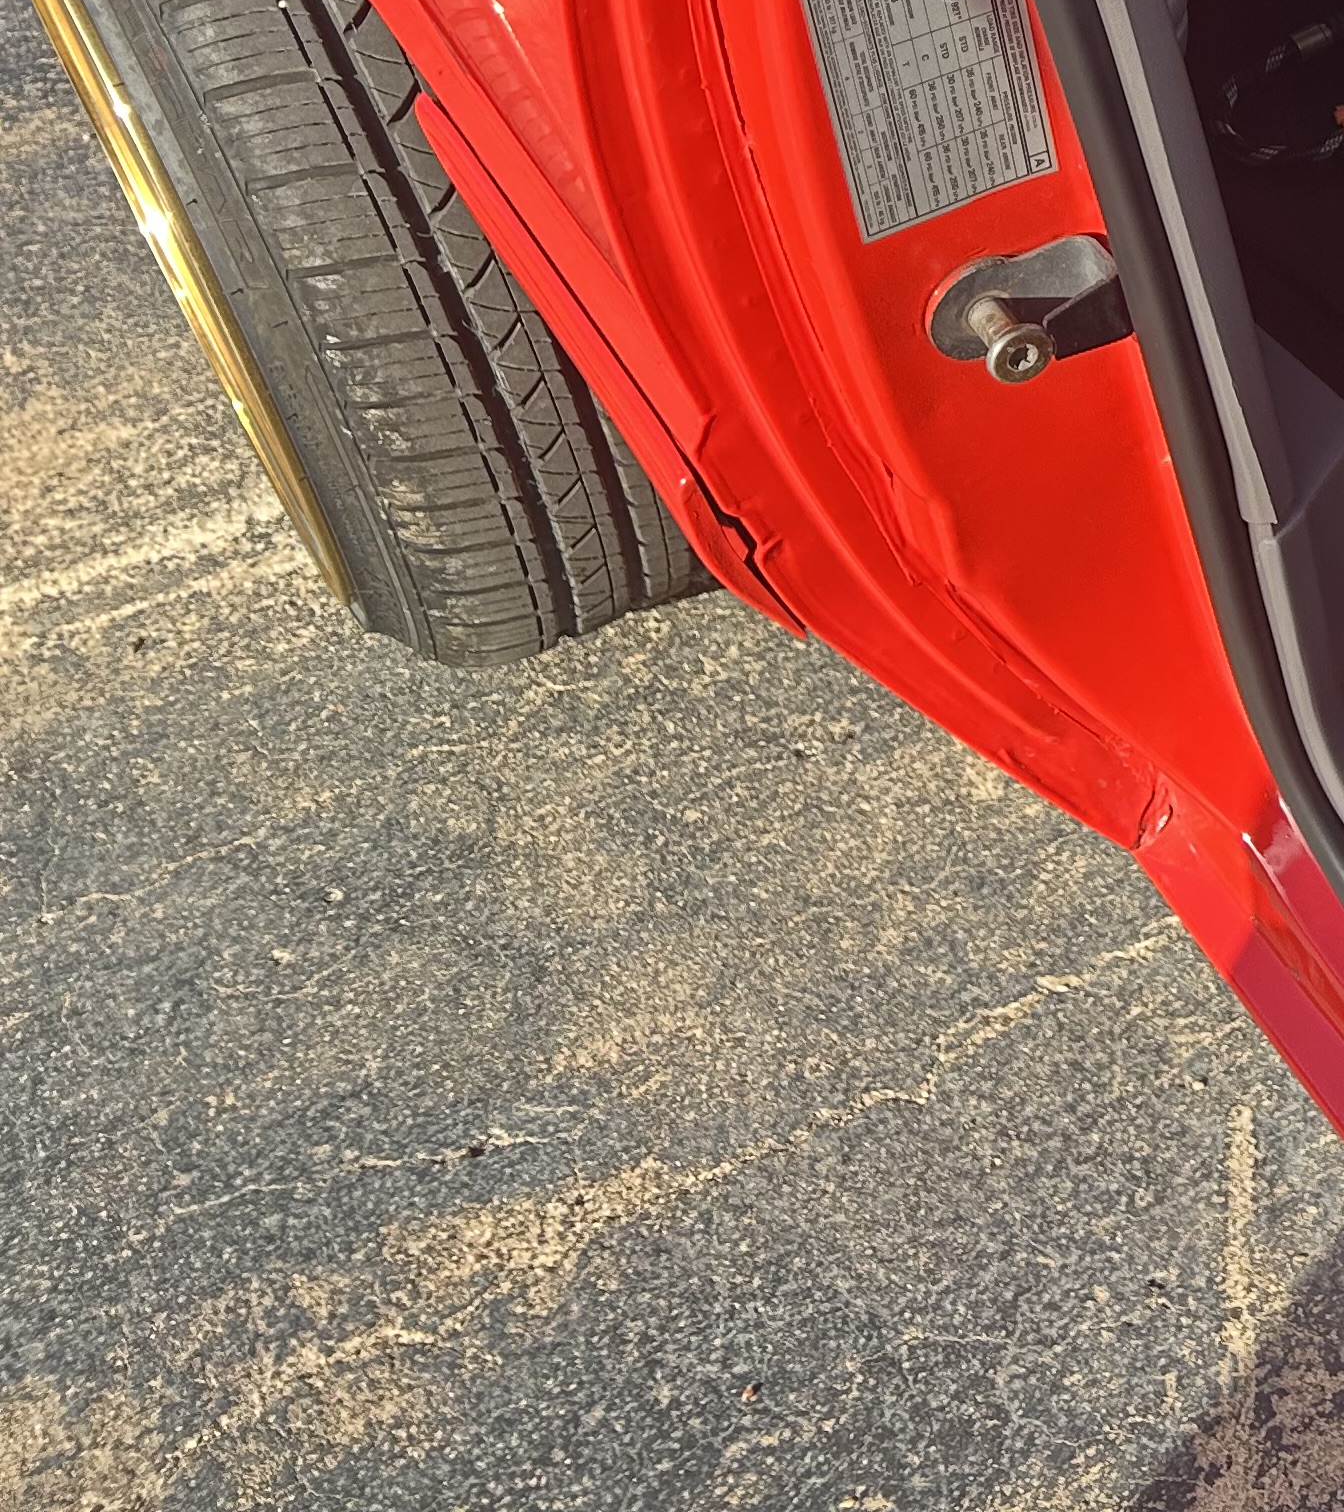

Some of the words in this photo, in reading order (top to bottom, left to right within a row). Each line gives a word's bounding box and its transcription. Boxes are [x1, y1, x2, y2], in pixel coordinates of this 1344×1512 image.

[957, 34, 969, 53] STD
[920, 53, 929, 61] C
[938, 41, 951, 60] STD
[901, 60, 910, 68] T
[1033, 155, 1045, 168] A
